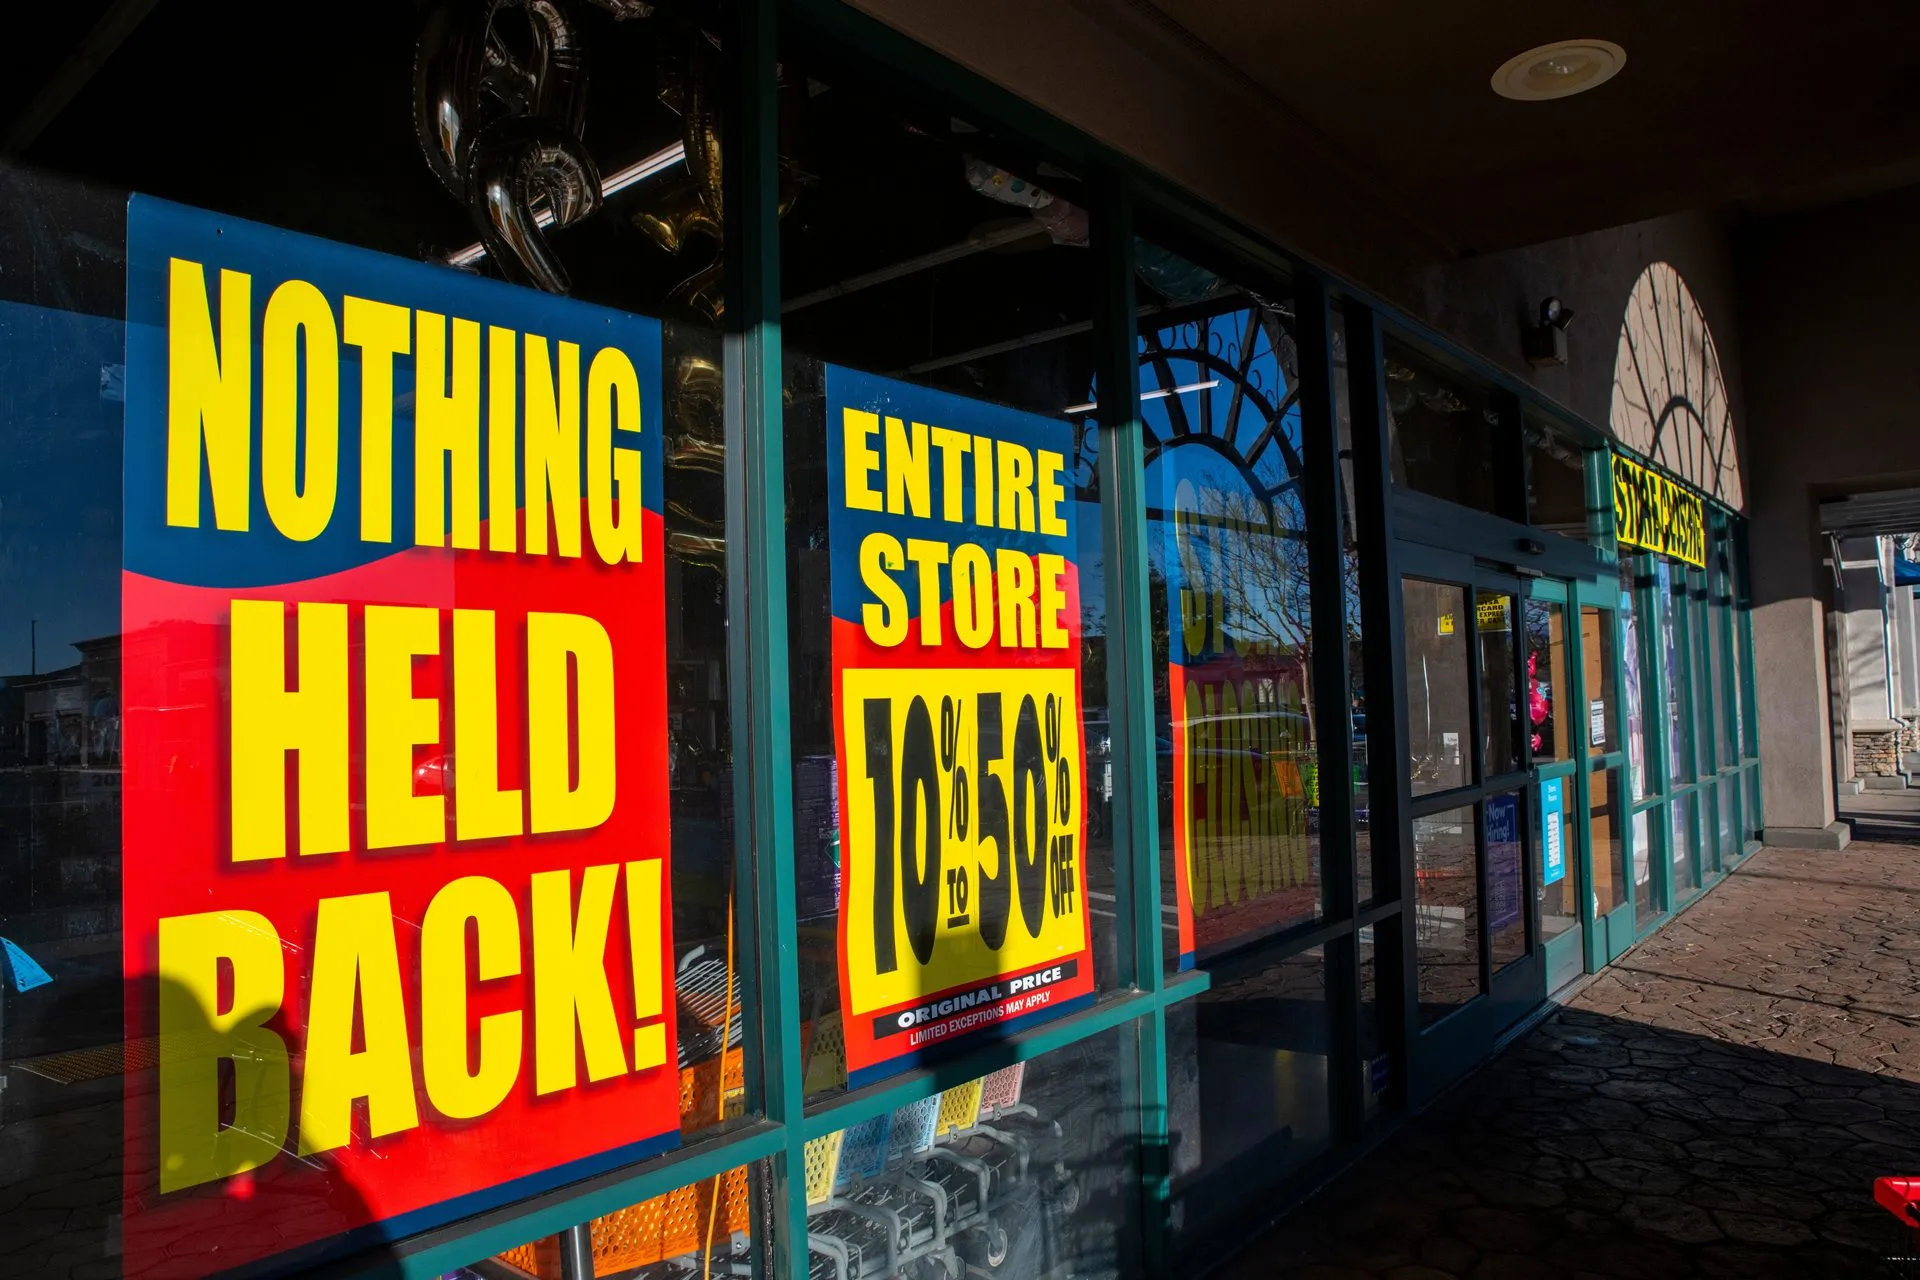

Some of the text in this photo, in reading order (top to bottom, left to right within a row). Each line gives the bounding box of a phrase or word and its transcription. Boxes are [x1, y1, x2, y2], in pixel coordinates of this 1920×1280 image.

[166, 257, 643, 565] NOTHING
[842, 407, 1067, 536] ENTIRE
[859, 532, 1069, 649] STORE
[230, 600, 615, 863] HELD
[863, 694, 969, 976] 10%
[946, 865, 970, 915] TO
[976, 692, 1071, 951] 50%
[1050, 833, 1075, 919] OFF
[1488, 803, 1506, 823] Now
[158, 856, 667, 1195] BACK!
[897, 966, 1062, 1028] ORIGINAL PRICE
[909, 990, 1051, 1046] LIMITED EXCEPTIONS MAY APPLY
